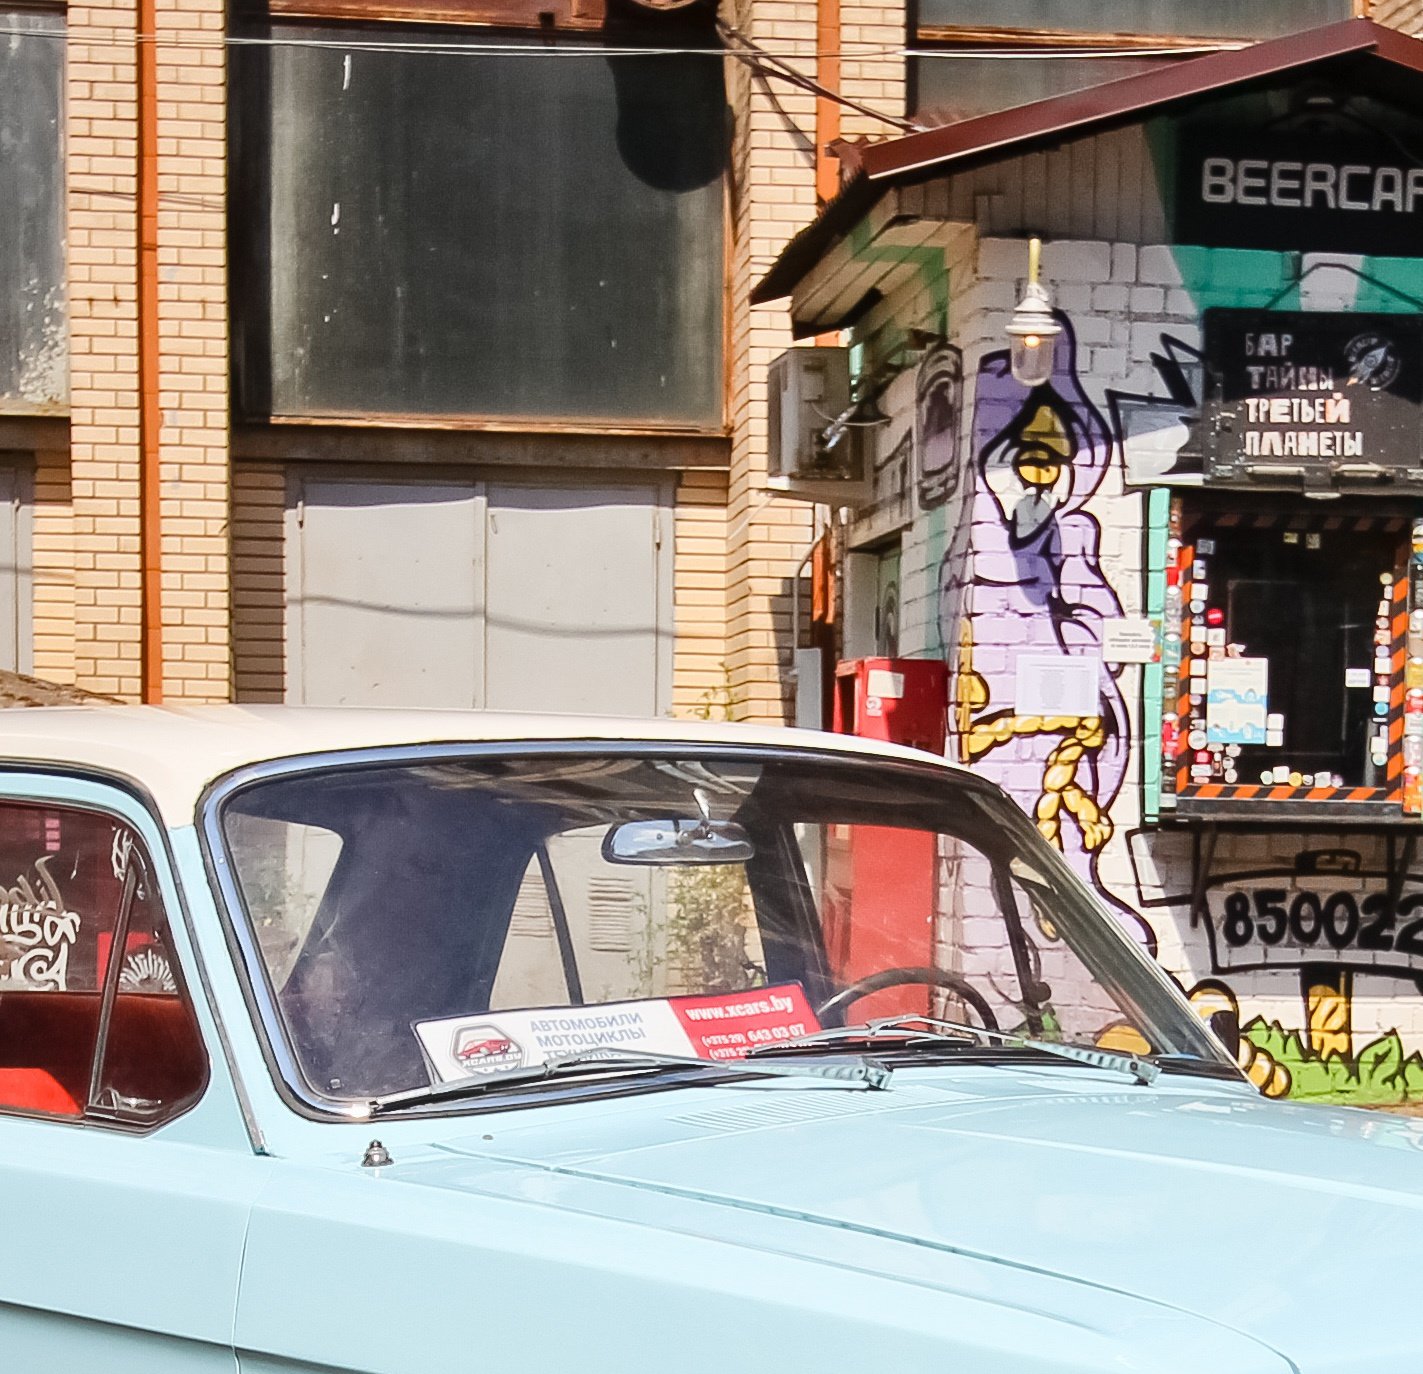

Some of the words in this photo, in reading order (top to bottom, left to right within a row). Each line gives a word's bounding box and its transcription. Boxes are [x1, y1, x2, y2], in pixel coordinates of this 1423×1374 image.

[1245, 332, 1293, 356] БАР
[1244, 392, 1351, 424] ТРЕТЬЕЙ
[1243, 431, 1364, 457] ПЛАНЕТЫ
[684, 994, 794, 1022] www.xcars.by
[530, 1012, 644, 1033] АВТОМОБИЛИ
[747, 1028, 773, 1043] 643
[772, 1025, 790, 1039] 03
[536, 1027, 647, 1048] МОТОЦИКЛЫ
